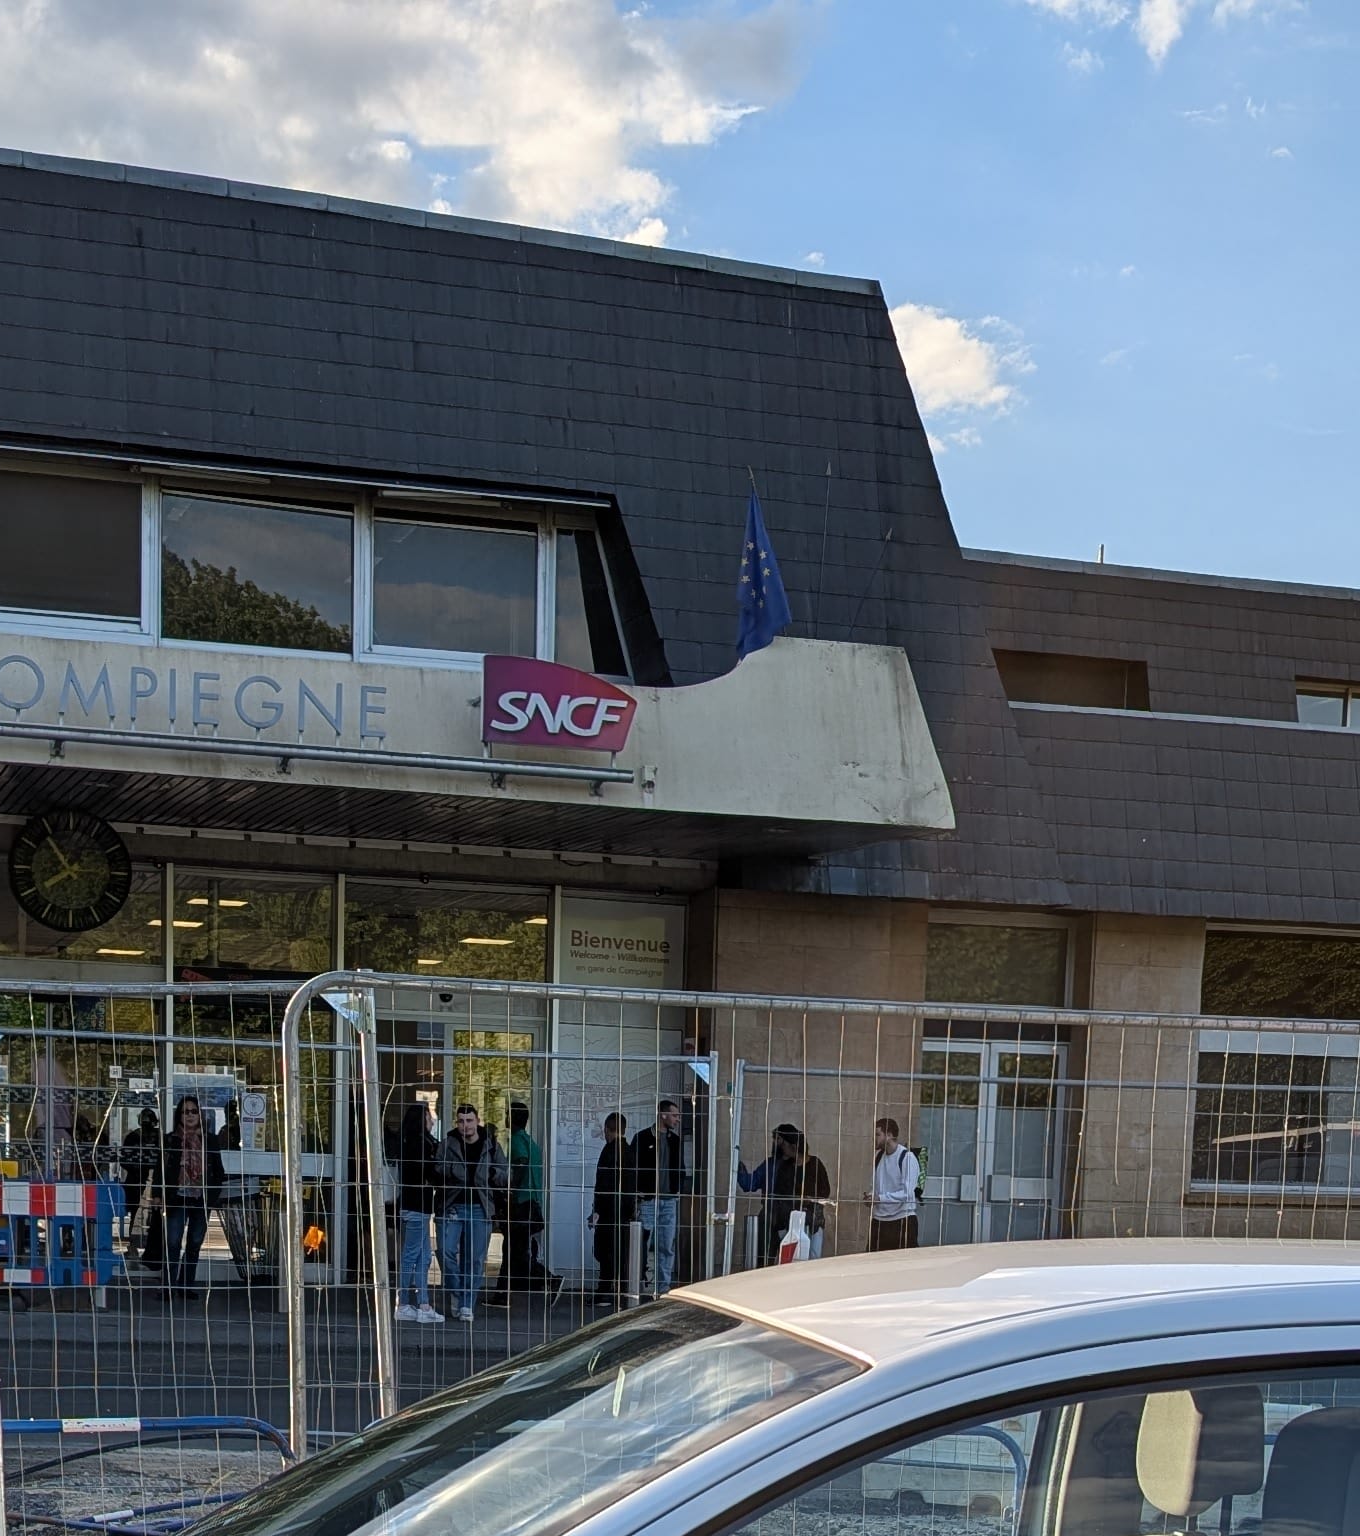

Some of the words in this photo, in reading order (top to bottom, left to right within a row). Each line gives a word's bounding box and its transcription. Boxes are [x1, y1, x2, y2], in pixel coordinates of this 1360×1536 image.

[490, 690, 629, 736] SNCF
[570, 929, 671, 953] Bienvenue
[570, 949, 610, 960] Welcome
[617, 952, 670, 964] Willkommen
[606, 965, 617, 974] de
